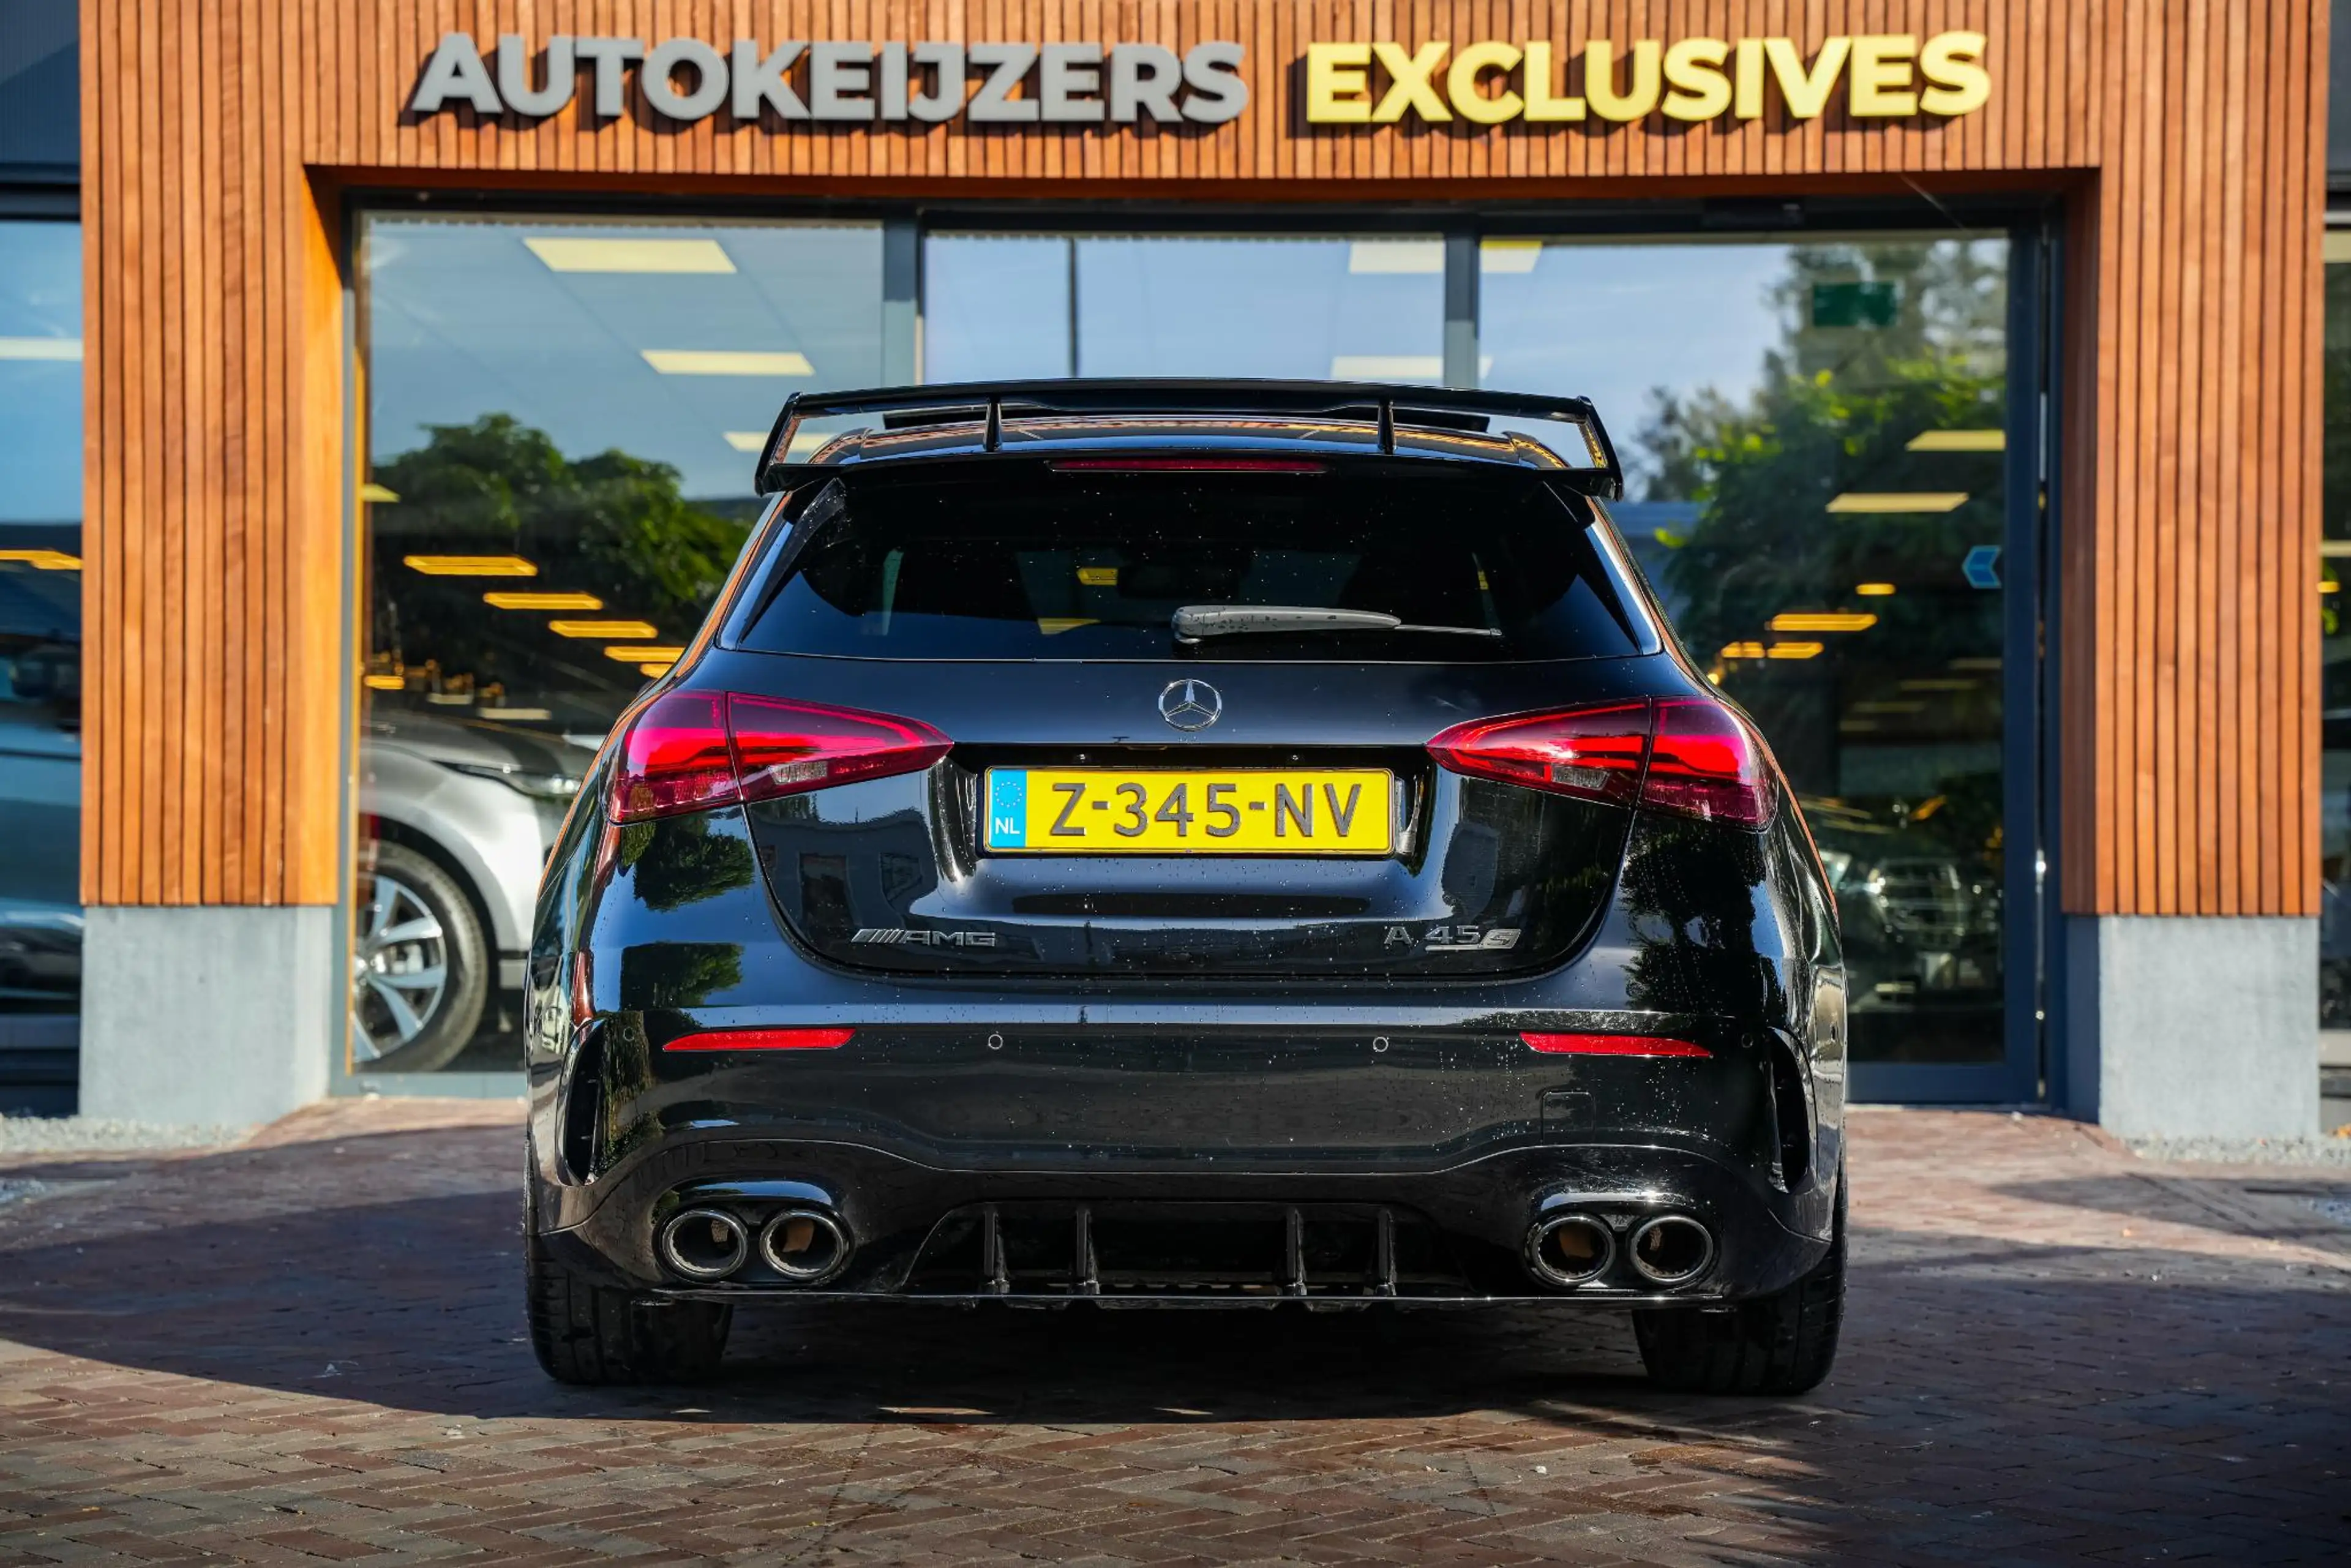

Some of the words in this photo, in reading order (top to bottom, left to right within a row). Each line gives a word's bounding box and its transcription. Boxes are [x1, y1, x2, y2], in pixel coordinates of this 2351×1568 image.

[412, 32, 1250, 123] AUTOKEIJZERS
[1306, 31, 1992, 124] EXCLUSIVES
[994, 817, 1021, 835] NL
[1050, 782, 1362, 838] Z-345-NV
